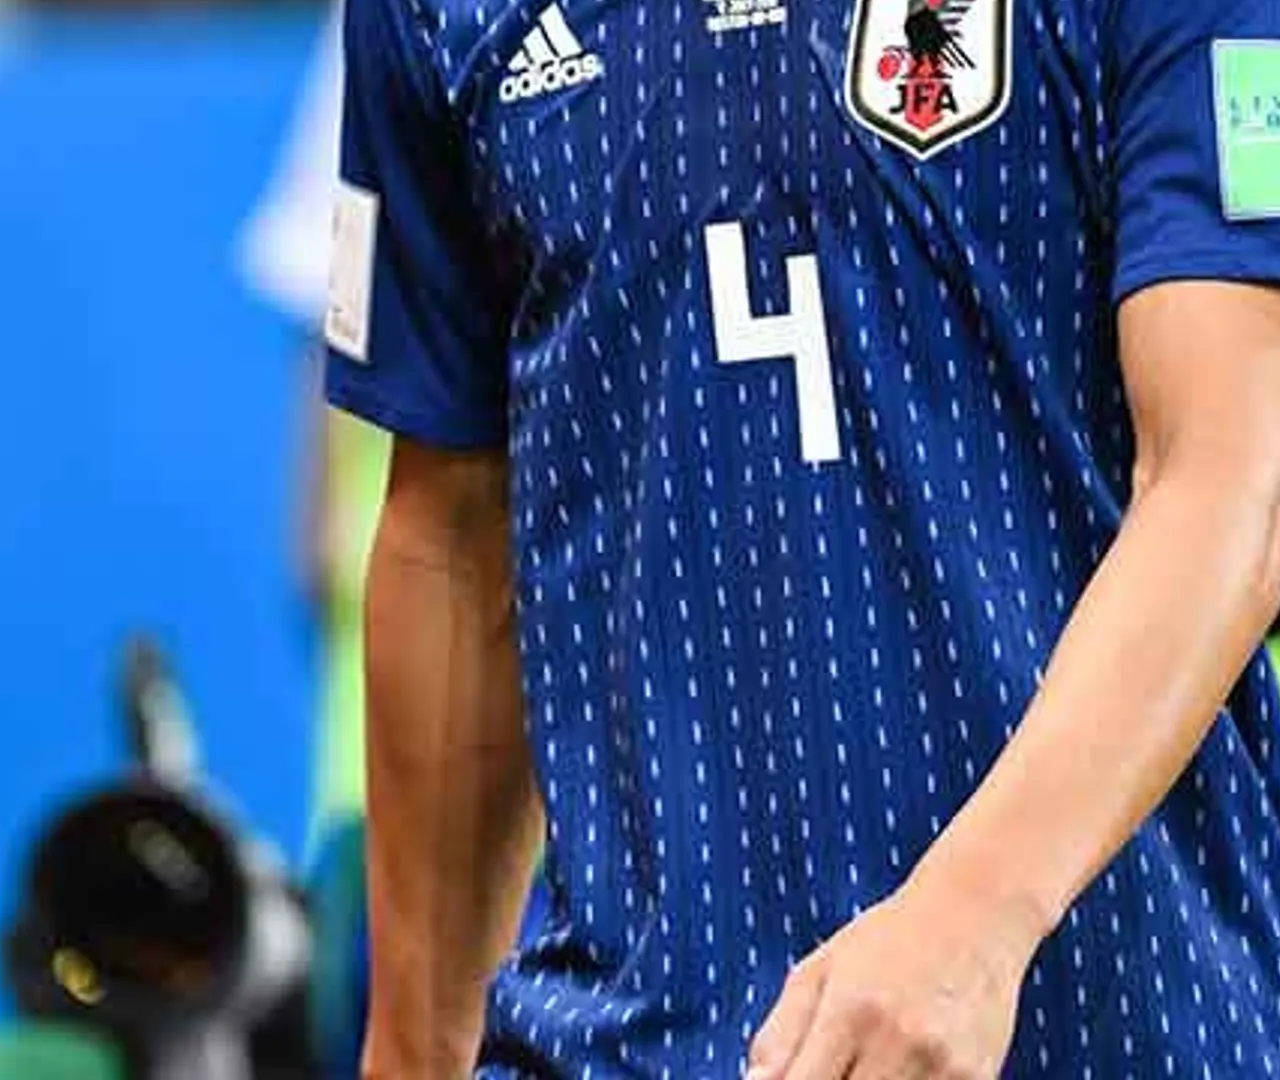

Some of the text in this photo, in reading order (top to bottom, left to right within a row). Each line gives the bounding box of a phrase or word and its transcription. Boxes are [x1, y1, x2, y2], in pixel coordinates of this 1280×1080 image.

[499, 53, 599, 102] adidas
[888, 83, 960, 114] JFA
[704, 221, 842, 462] 4
